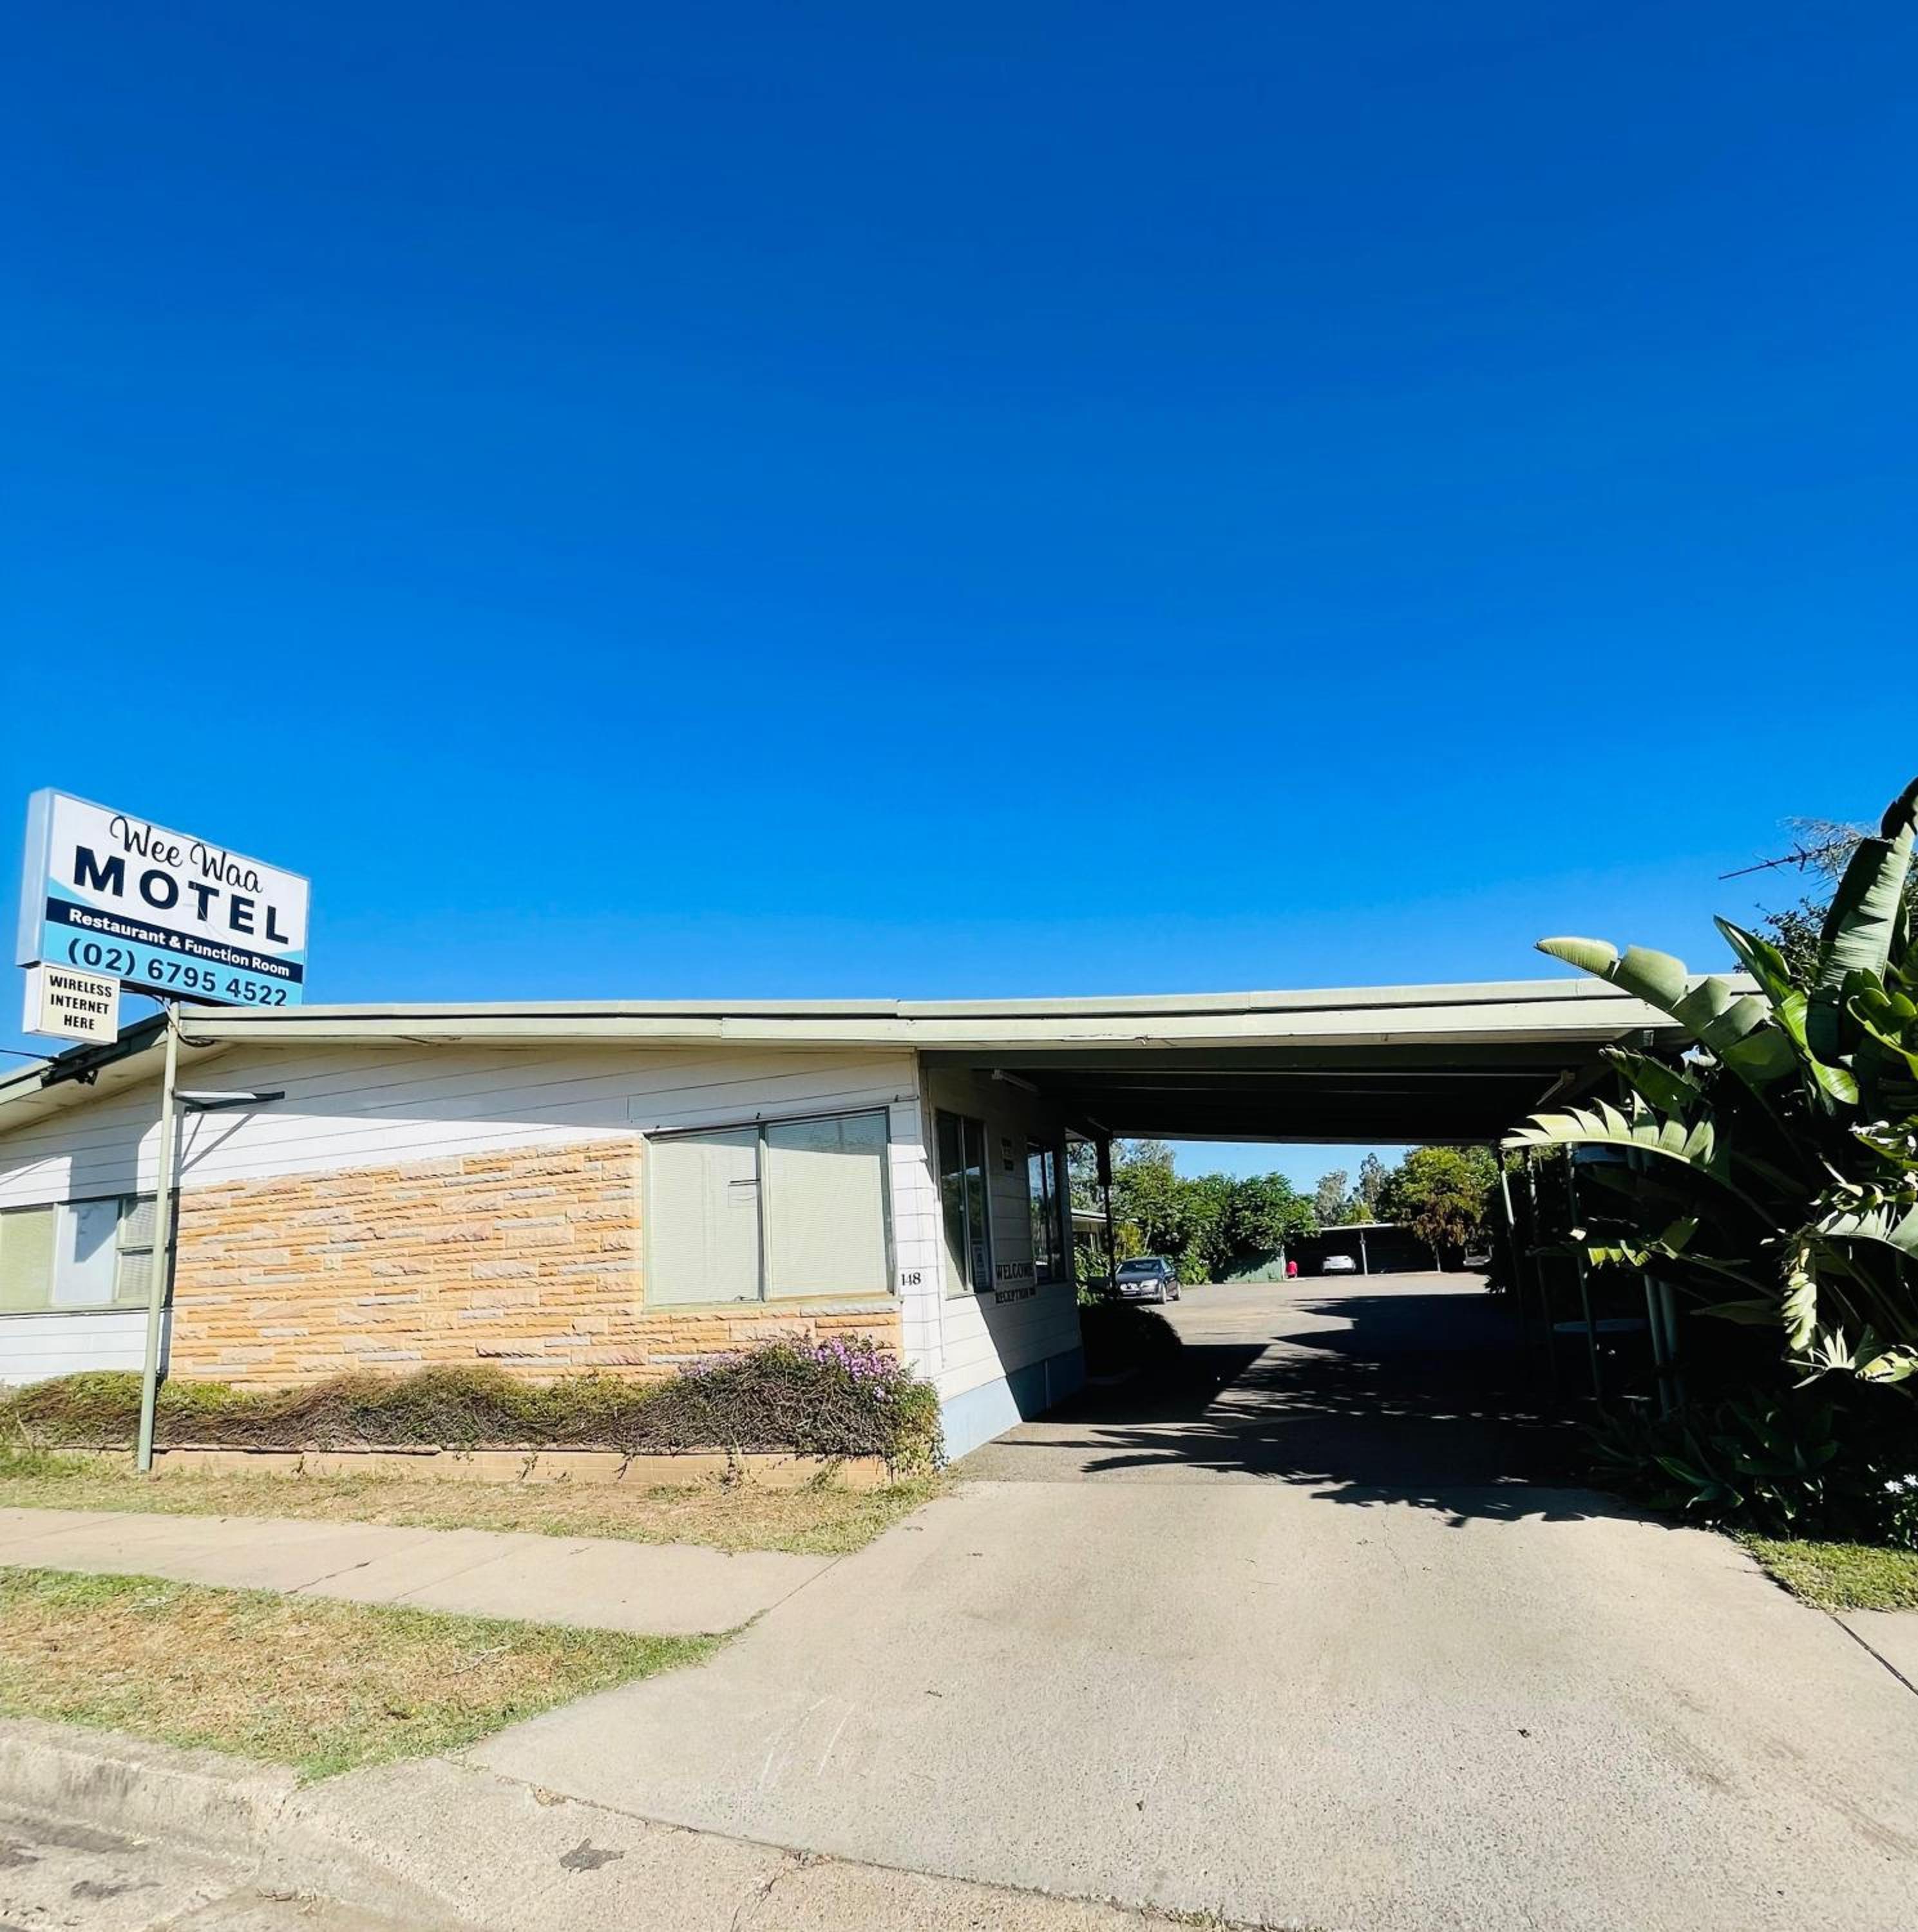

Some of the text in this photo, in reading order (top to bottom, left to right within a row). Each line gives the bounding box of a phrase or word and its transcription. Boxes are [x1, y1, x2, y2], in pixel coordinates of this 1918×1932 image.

[110, 815, 263, 893] Wee Waa
[73, 845, 289, 945] MOTEL
[69, 908, 289, 977] Restaurant & Function Room
[50, 974, 111, 998] WIRELESS
[68, 938, 287, 1006] (02) 6795 4522
[50, 994, 109, 1014] INTERNET
[64, 1014, 95, 1030] HERE
[902, 1272, 921, 1286] 148
